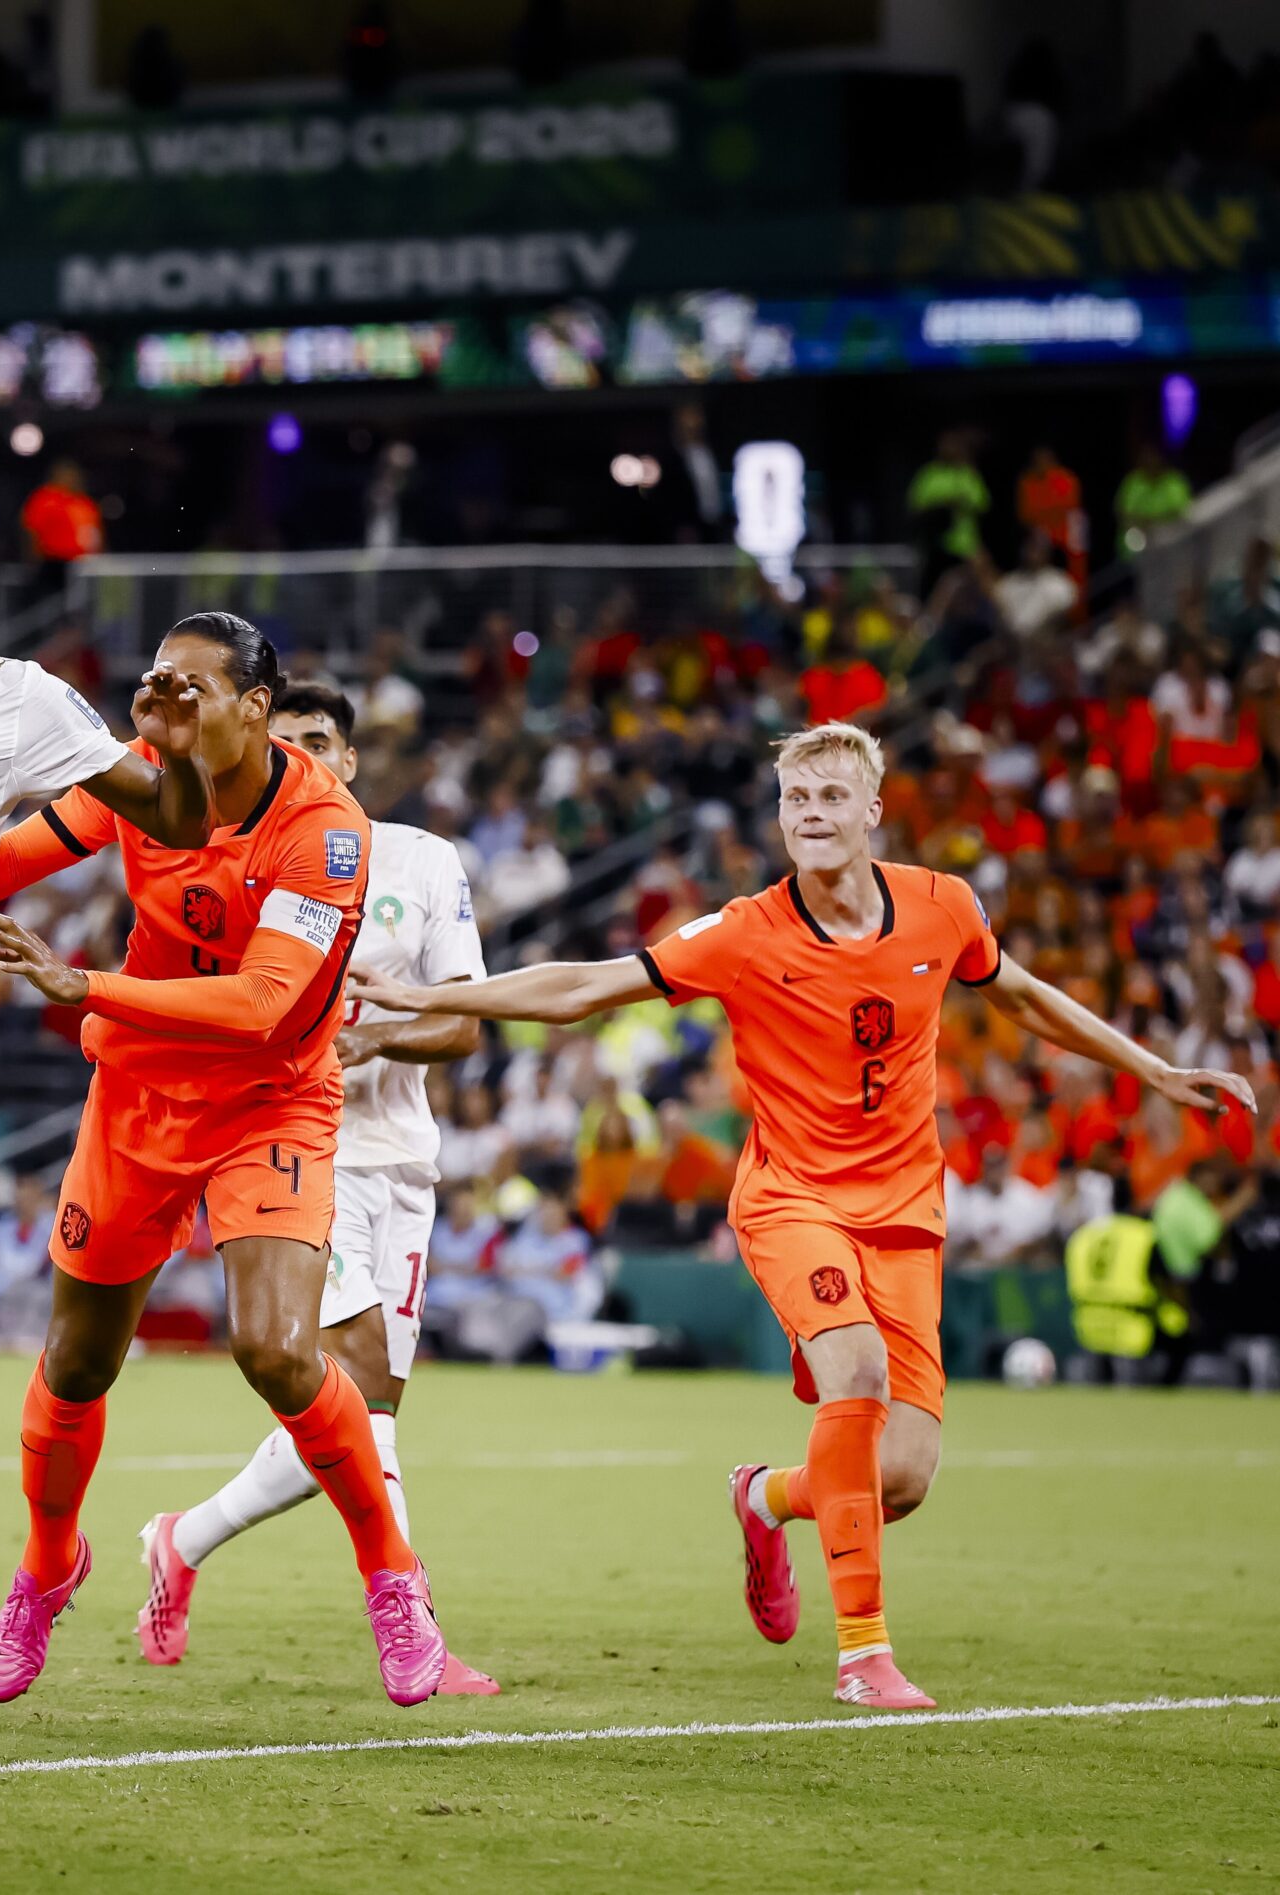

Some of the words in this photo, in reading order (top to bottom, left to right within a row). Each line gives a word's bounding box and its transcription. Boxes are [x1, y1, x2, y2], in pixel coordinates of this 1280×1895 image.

[143, 118, 347, 176] WORLD
[351, 113, 464, 168] CUP
[472, 103, 678, 163] 2026
[61, 229, 634, 312] MONTERREY
[333, 855, 342, 865] the
[334, 845, 357, 857] UNITES
[293, 915, 312, 928] the
[298, 902, 337, 932] UNITES
[861, 1059, 886, 1113] 6
[269, 1143, 301, 1196] 4
[396, 1252, 428, 1320] 1
